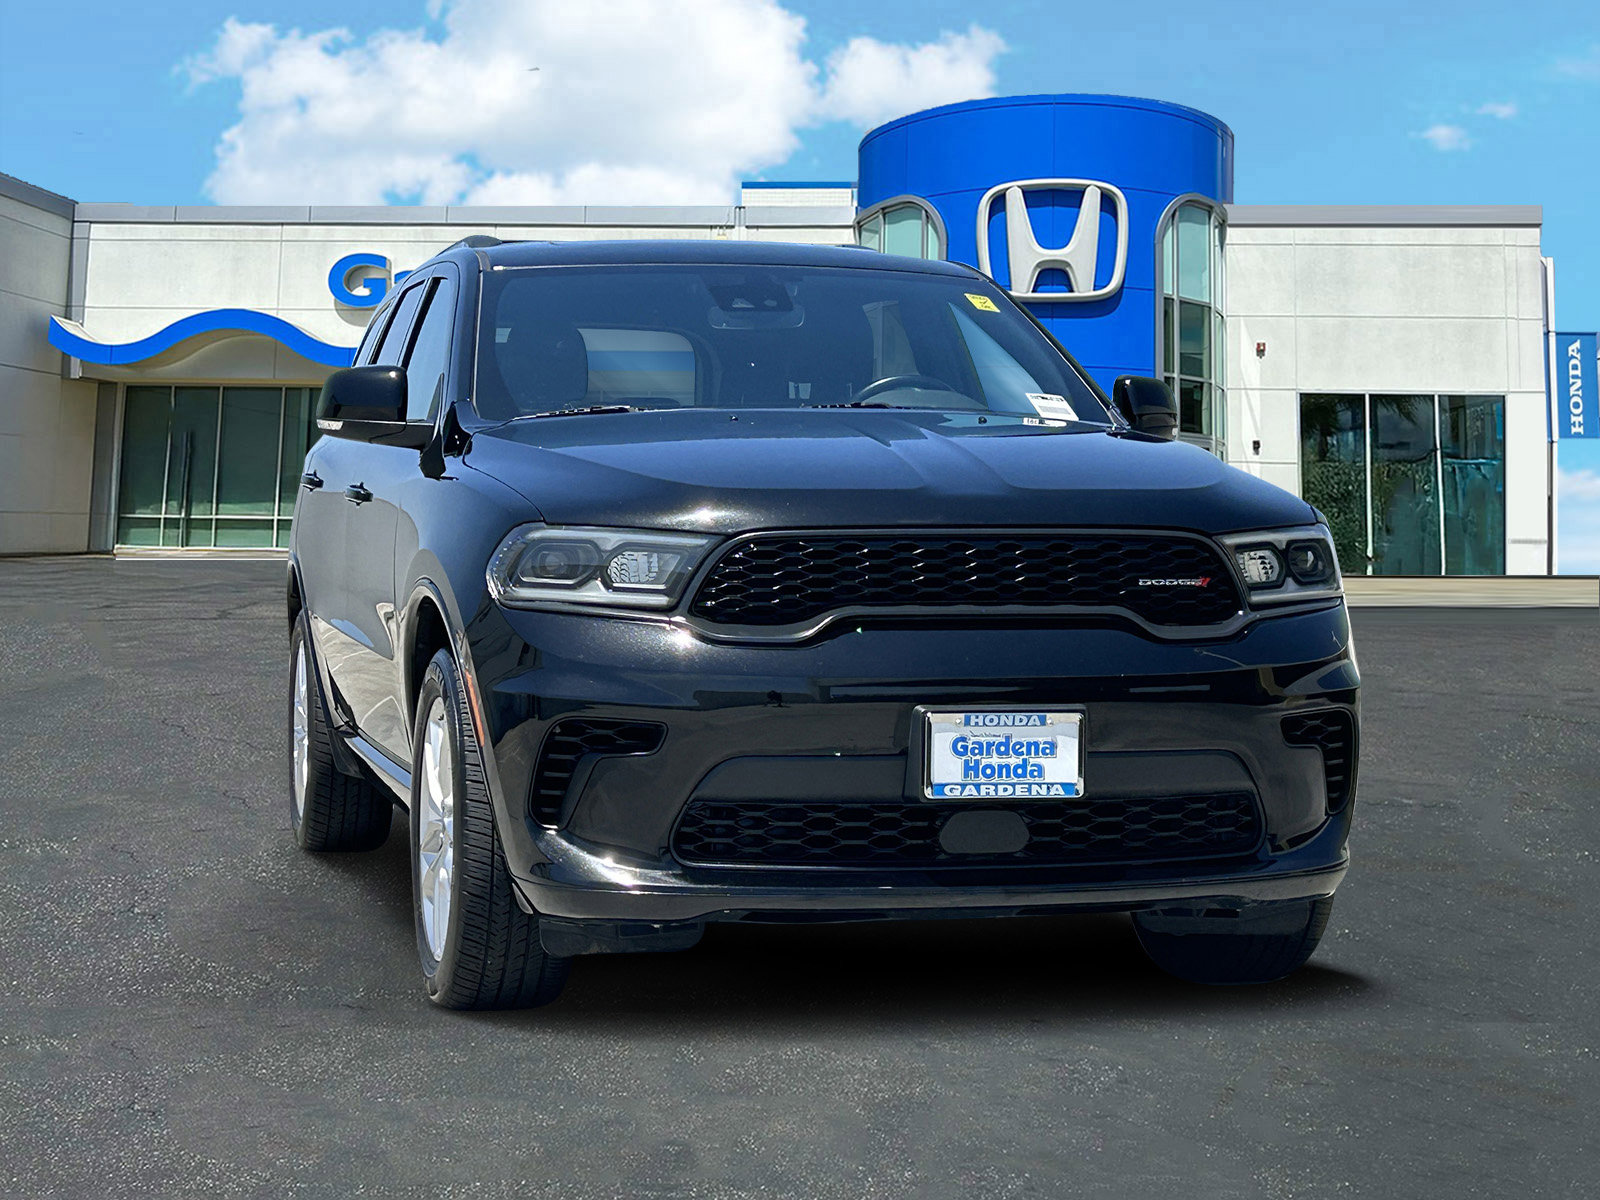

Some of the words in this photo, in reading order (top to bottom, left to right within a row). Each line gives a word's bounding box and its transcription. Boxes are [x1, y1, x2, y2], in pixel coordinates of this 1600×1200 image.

[1568, 339, 1584, 435] HONDA
[969, 715, 1041, 726] HONDA
[951, 735, 1056, 758] Gardena
[963, 758, 1043, 780] Honda
[943, 784, 1065, 796] GARDENA
